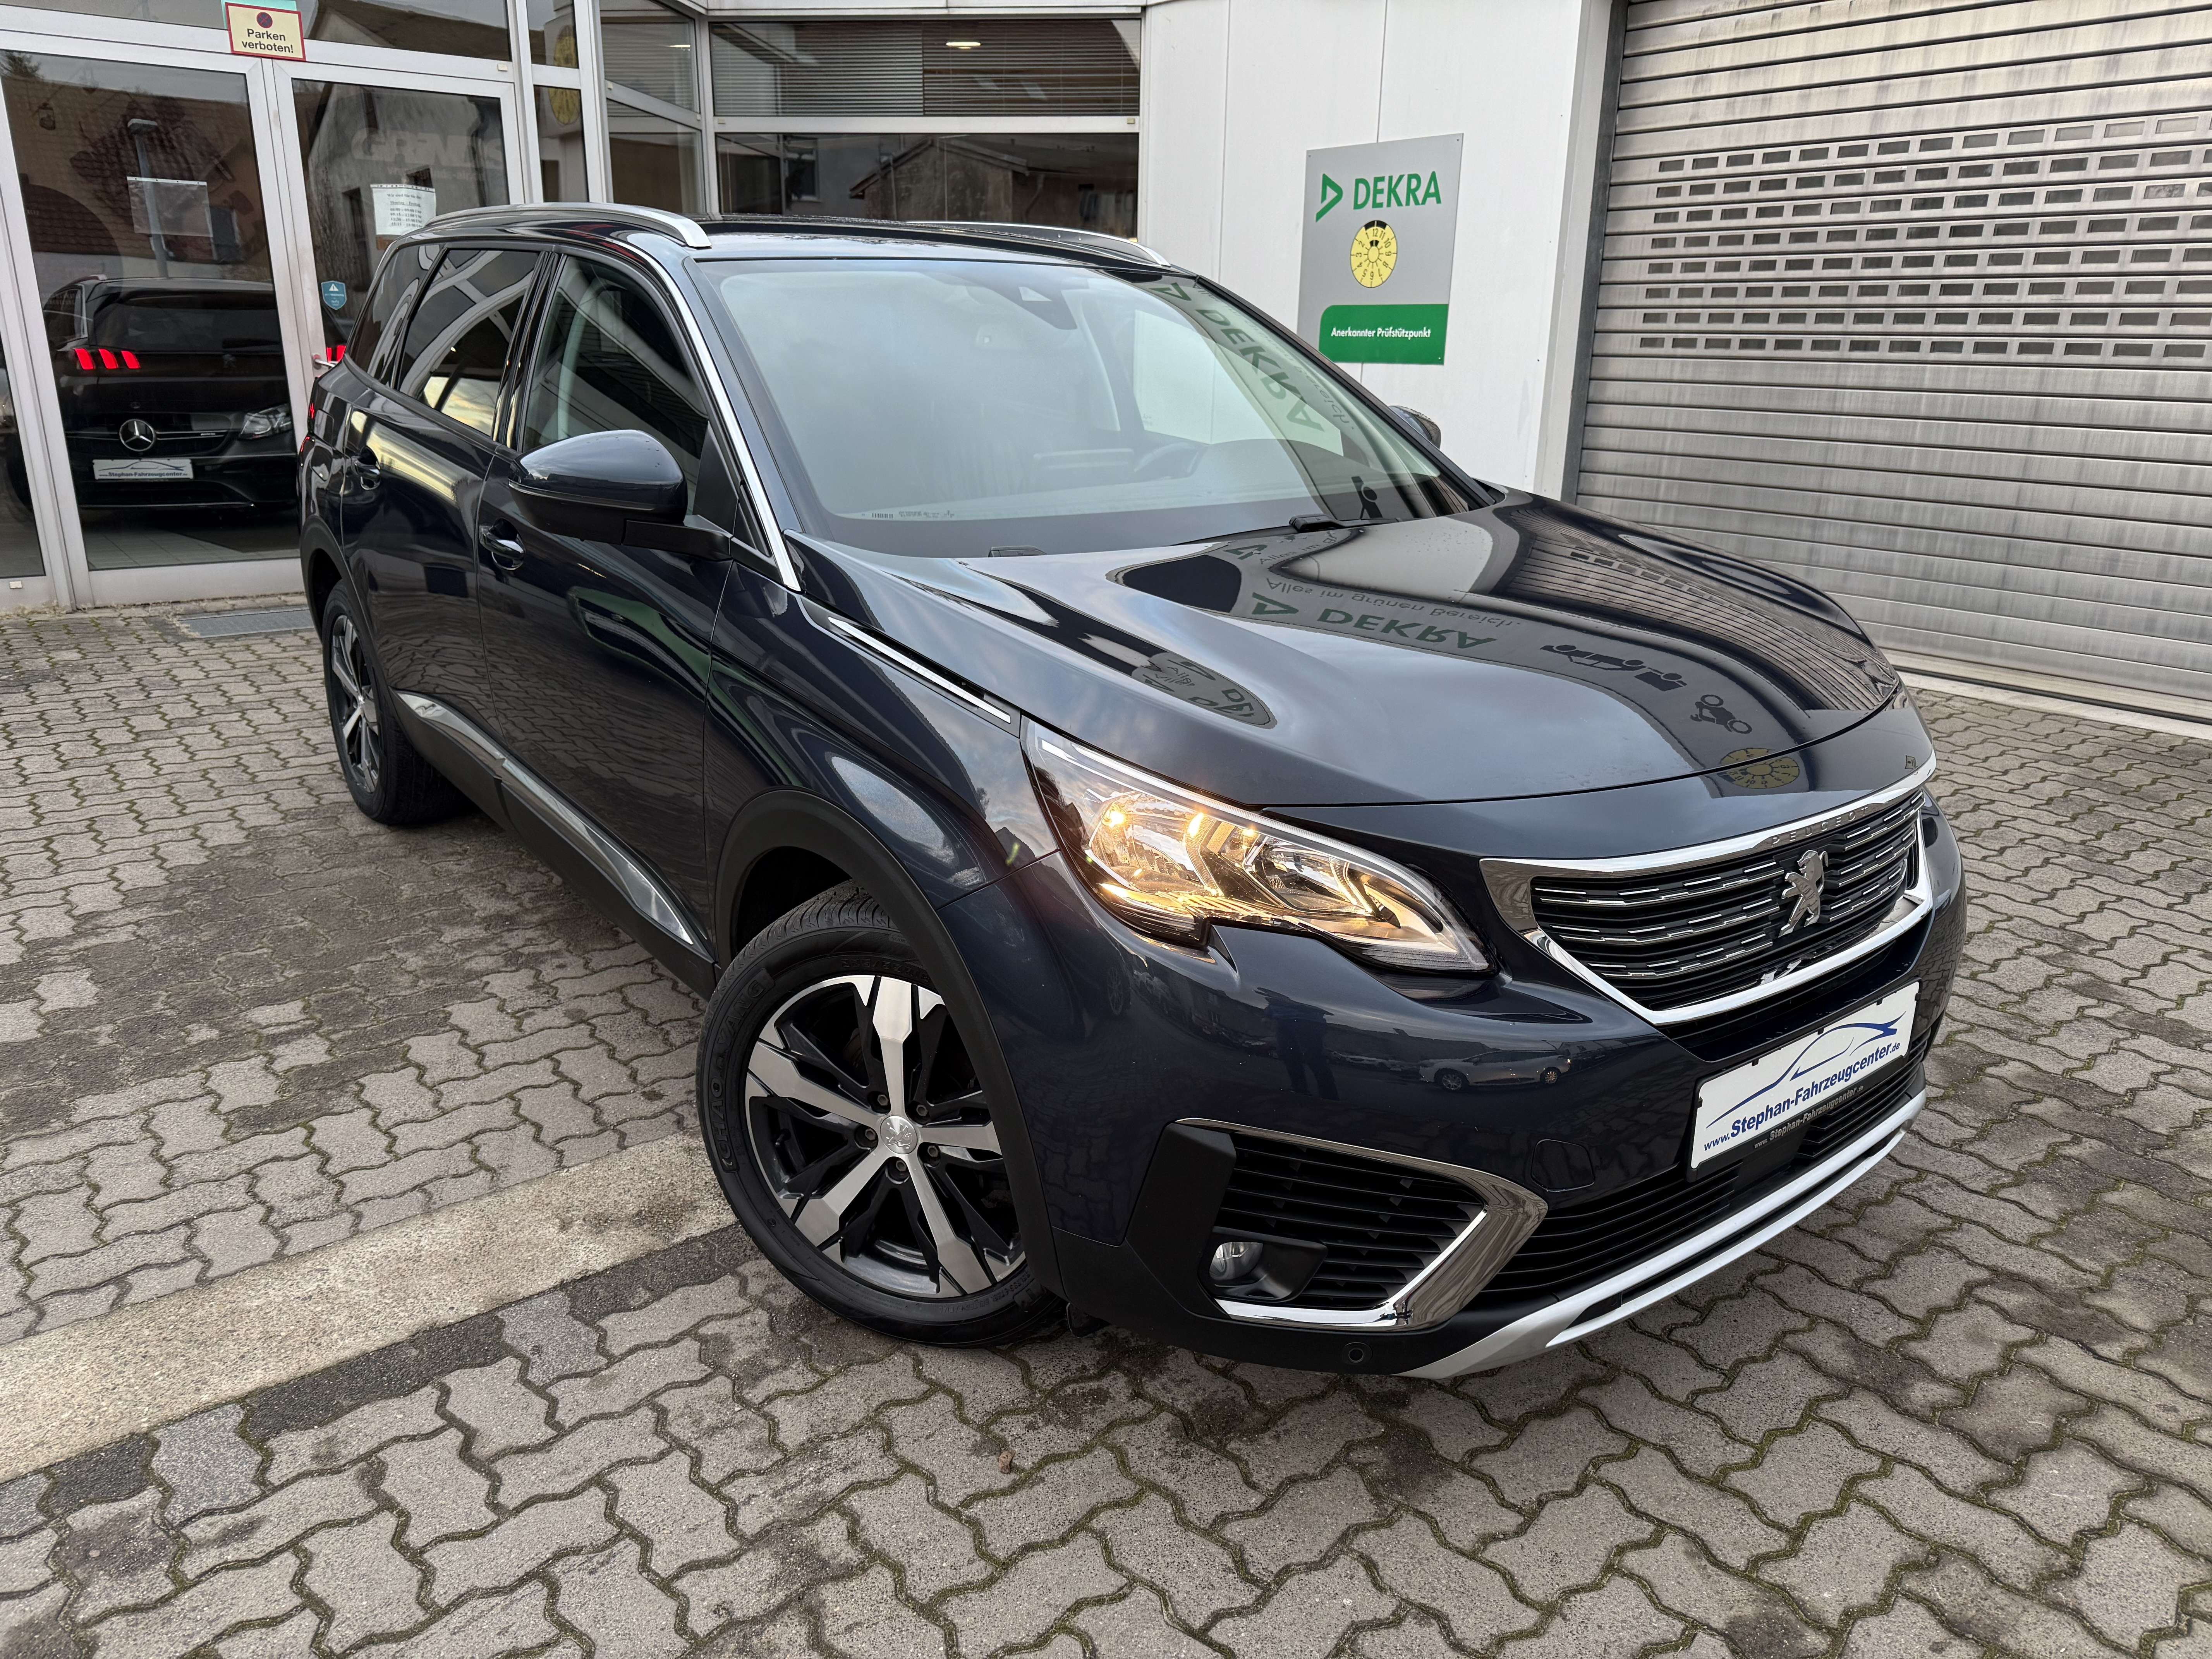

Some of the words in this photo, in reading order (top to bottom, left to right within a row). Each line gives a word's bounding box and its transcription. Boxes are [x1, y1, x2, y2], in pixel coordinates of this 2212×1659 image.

[247, 28, 285, 41] Parken
[242, 41, 294, 53] verboten!
[1353, 171, 1442, 210] DEKRA
[1372, 228, 1379, 237] 12
[1379, 230, 1386, 240] 11
[1384, 238, 1391, 248] 10
[1362, 269, 1367, 277] 5
[1378, 268, 1382, 277] 7
[1331, 326, 1376, 337] Anerkannter
[1377, 326, 1431, 340] Prüfstützpunkt
[1771, 807, 1868, 847] PEUGEOT
[1704, 1042, 1901, 1151] www.Stephan-Fahrzeugcenter.de
